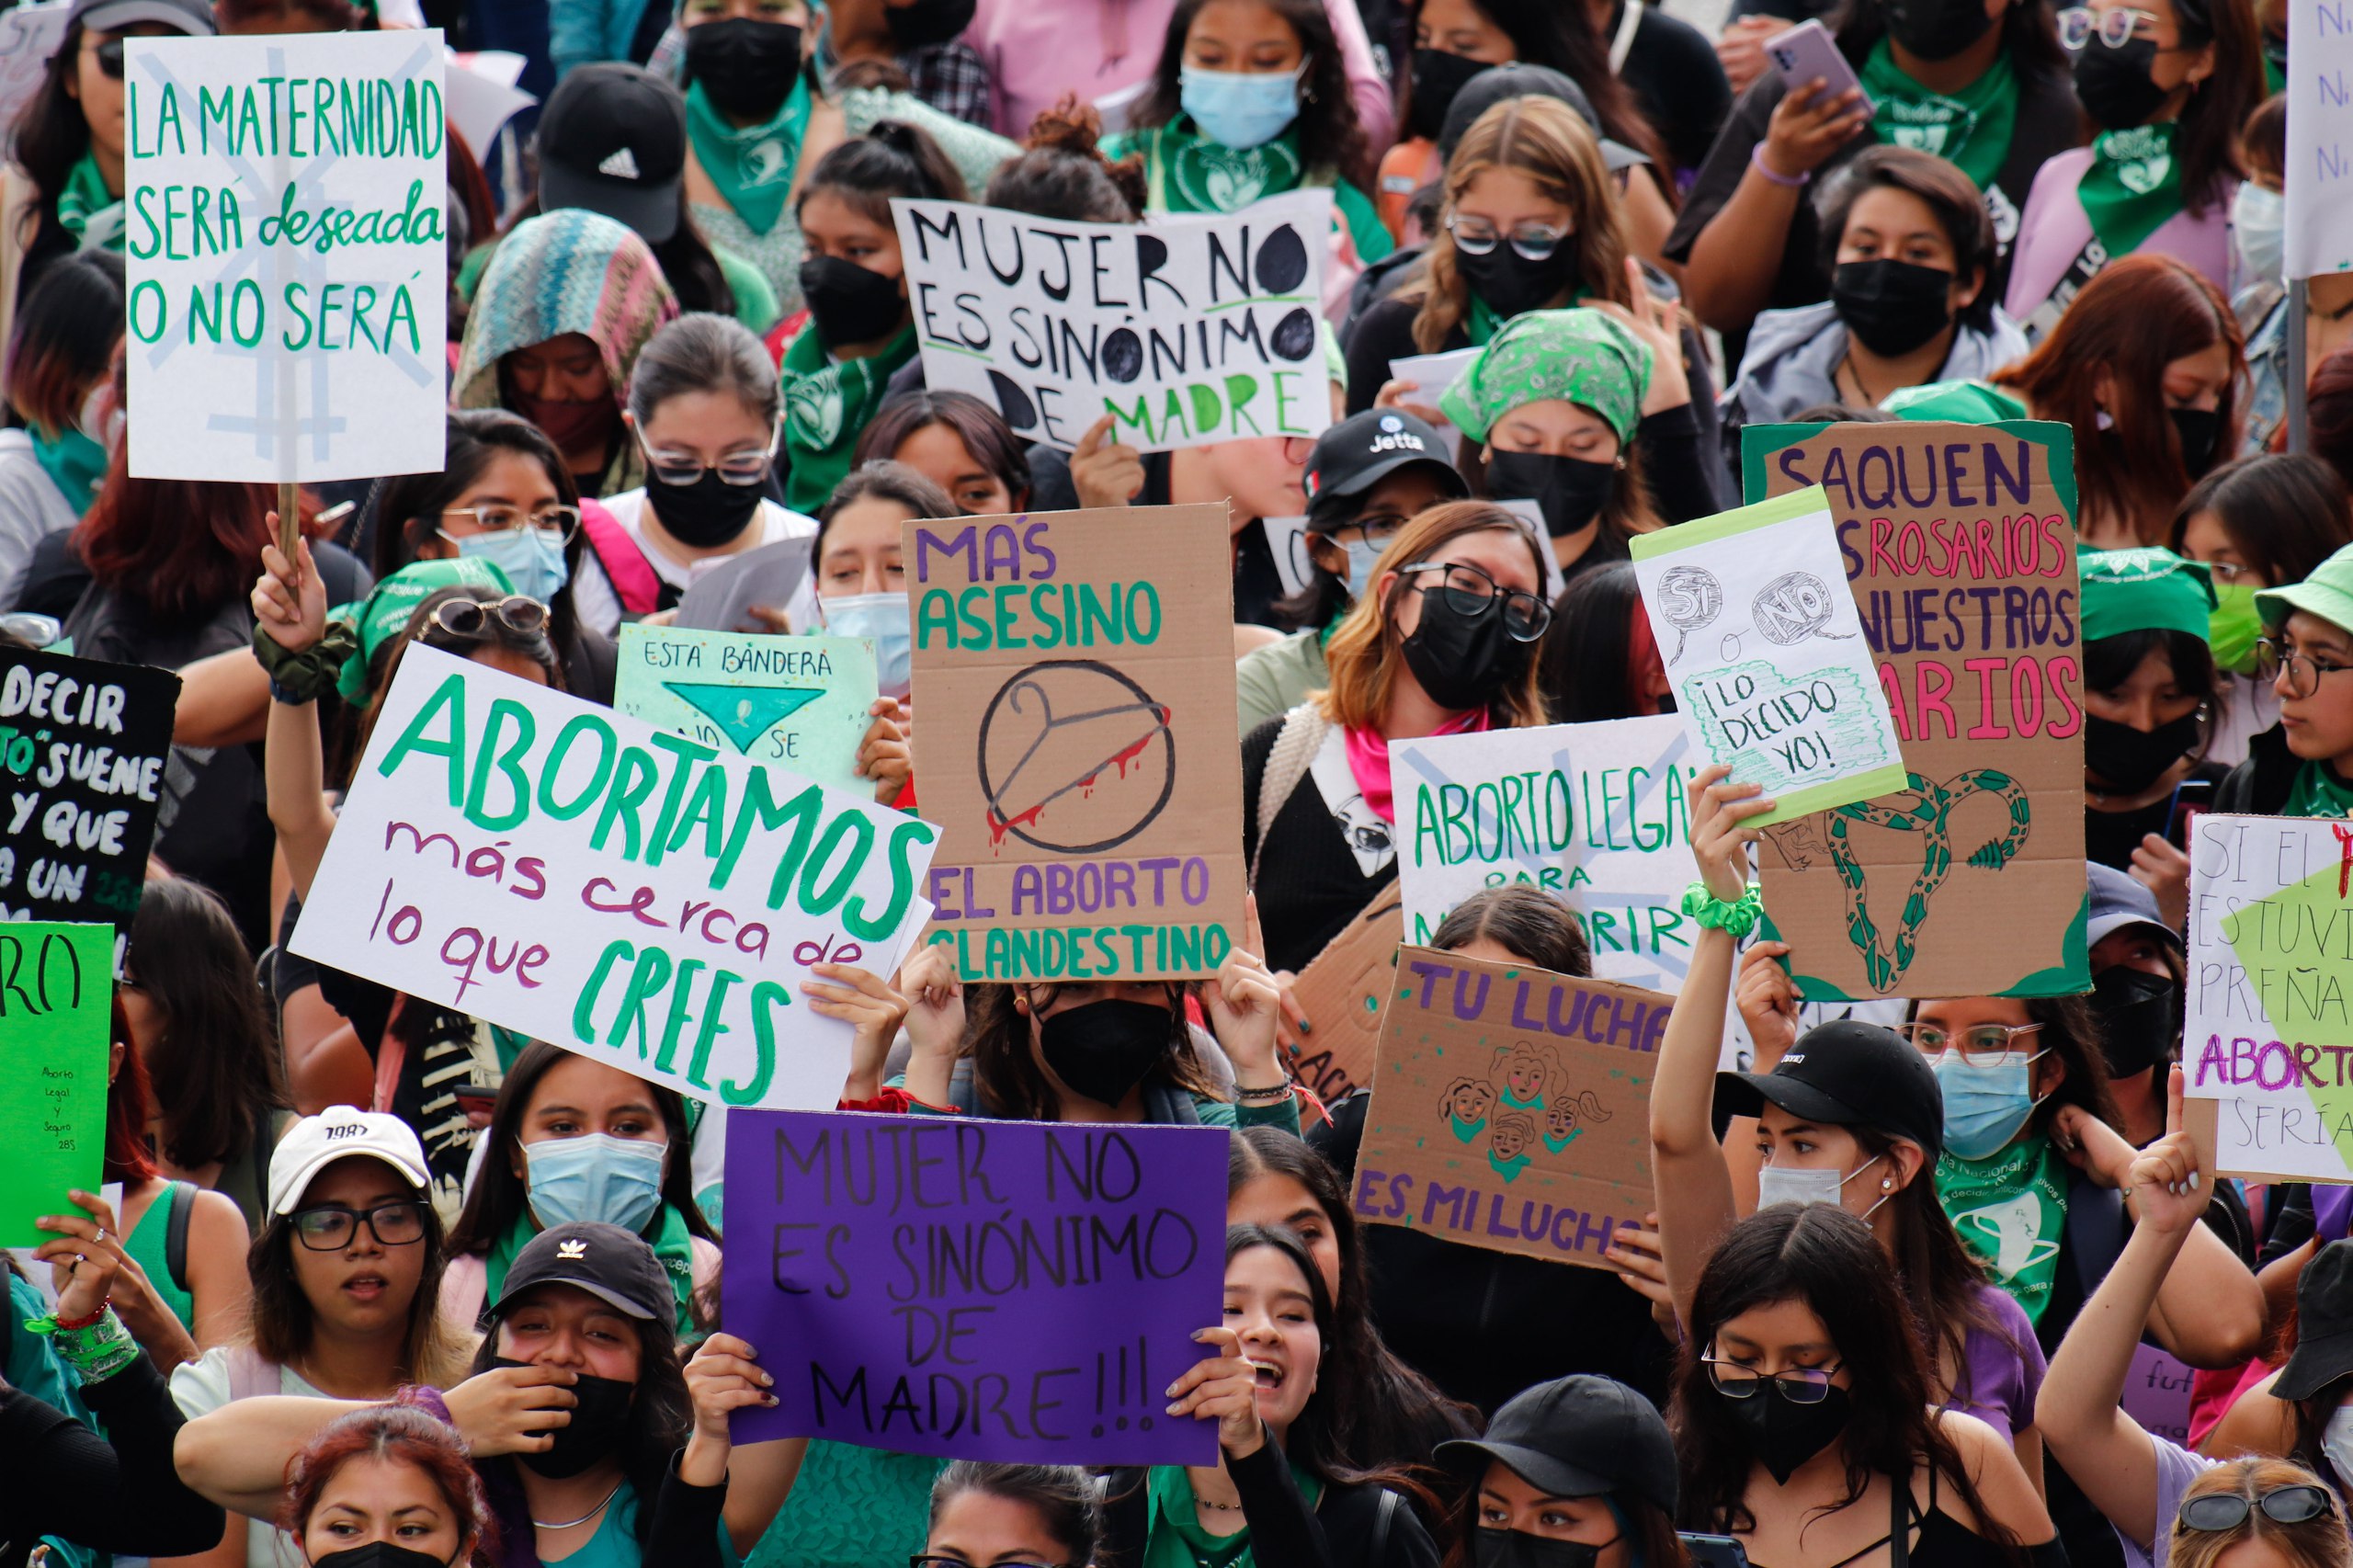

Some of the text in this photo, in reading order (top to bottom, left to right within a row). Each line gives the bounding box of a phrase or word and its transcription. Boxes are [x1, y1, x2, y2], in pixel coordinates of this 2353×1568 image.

[130, 76, 444, 159] LA MATERNIDAD
[130, 176, 445, 261] SERÁ deseada
[910, 208, 1308, 309] MUJER NO
[130, 271, 422, 355] O NO SERÁ
[918, 282, 1315, 383] ES SINÓNIMO
[987, 369, 1311, 448] DE MADRE
[1369, 431, 1426, 453] Jetta
[1779, 439, 2030, 510] SAQUEN
[915, 516, 1057, 584] MÁS
[1870, 513, 2066, 580] ROSARIOS
[917, 581, 1163, 651] ASESINO
[1760, 584, 1825, 641] NO
[1859, 585, 2075, 655] NUESTROS
[644, 642, 833, 676] ESTA BANDERA
[0, 665, 126, 734] DECIR
[1720, 680, 1837, 750] DECIDO
[1876, 655, 2082, 742] ARIOS
[37, 743, 163, 802] SUENE
[770, 729, 800, 758] SE
[1771, 731, 1836, 775] YO!
[6, 791, 130, 857] Y QUE
[378, 674, 934, 943] ABORTAMOS
[1415, 764, 1697, 868] ABORTO LEGA
[27, 858, 87, 903] UN
[2198, 822, 2250, 883] SI
[384, 821, 864, 968] más cerca de
[929, 856, 1211, 921] EL ABORTO
[369, 878, 791, 1107] lo que CREES
[1410, 960, 1493, 1021] TU
[2199, 961, 2349, 1027] PREÑA
[42, 1067, 74, 1079] Aborto
[45, 1087, 70, 1103] Legal
[2194, 1033, 2353, 1092] ABORT
[44, 1121, 71, 1138] Seguro
[775, 1122, 1142, 1218] MUJER NO
[1354, 1169, 1415, 1220] ES
[1421, 1181, 1478, 1233] MI
[1959, 1159, 2021, 1178] Nacional
[771, 1206, 1199, 1303] ES SINÓNIMO
[891, 1305, 996, 1368] DE
[809, 1335, 1154, 1441] MADRE!!!
